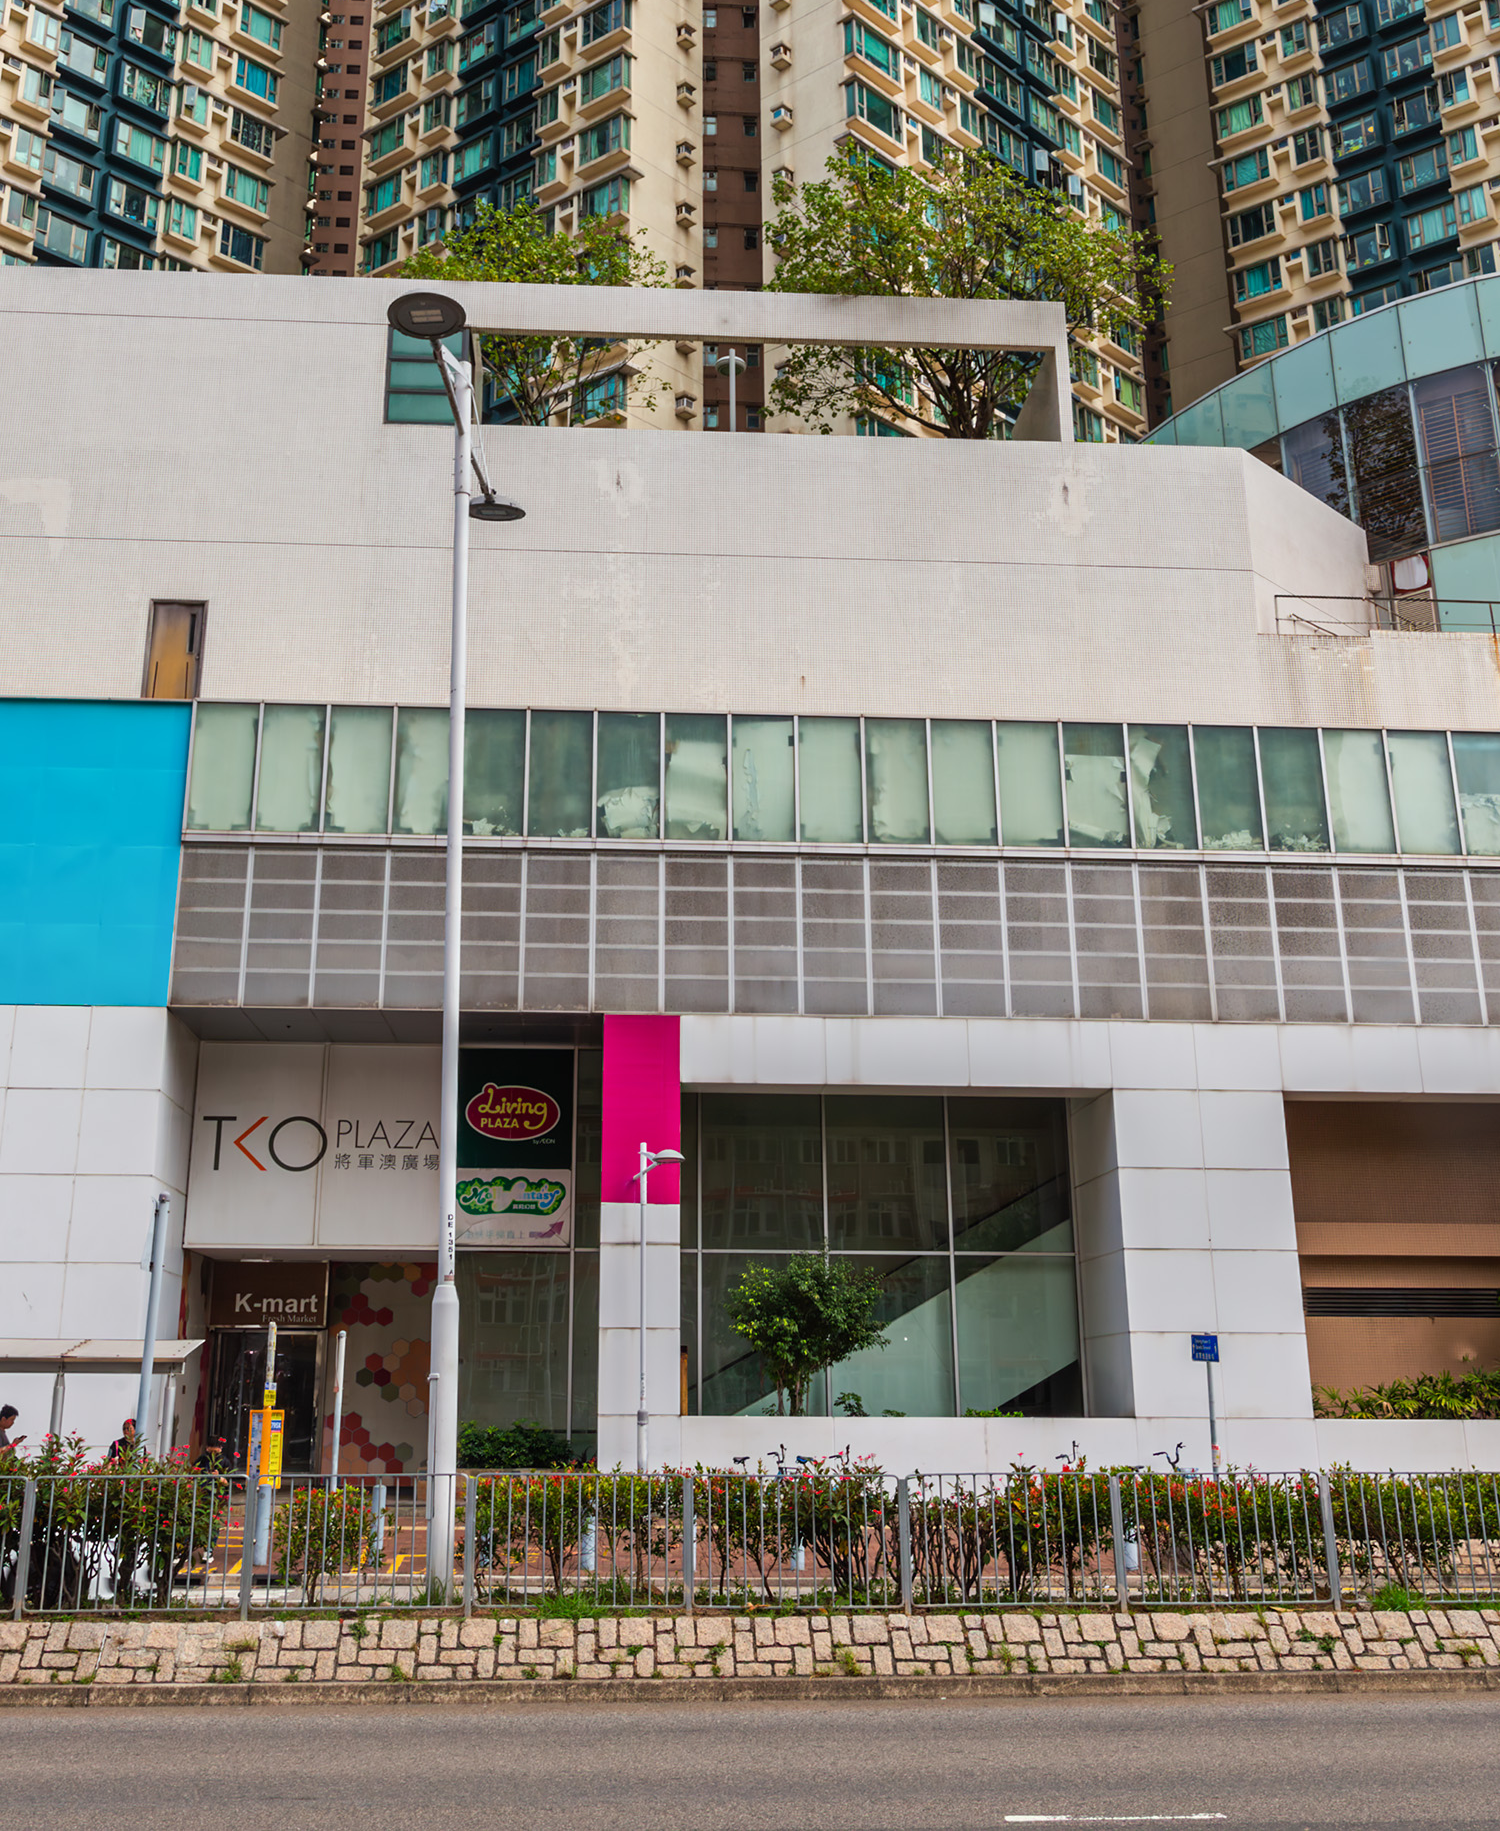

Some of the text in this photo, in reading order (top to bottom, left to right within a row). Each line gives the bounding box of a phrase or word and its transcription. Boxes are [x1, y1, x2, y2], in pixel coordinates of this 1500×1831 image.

[478, 1088, 547, 1130] Living
[480, 1117, 519, 1128] PLAZA
[203, 1116, 439, 1172] TKO PLAZA
[334, 1153, 440, 1170] 將軍澳廣場
[235, 1293, 318, 1313] K-mart
[262, 1314, 317, 1323] Fresh Market
